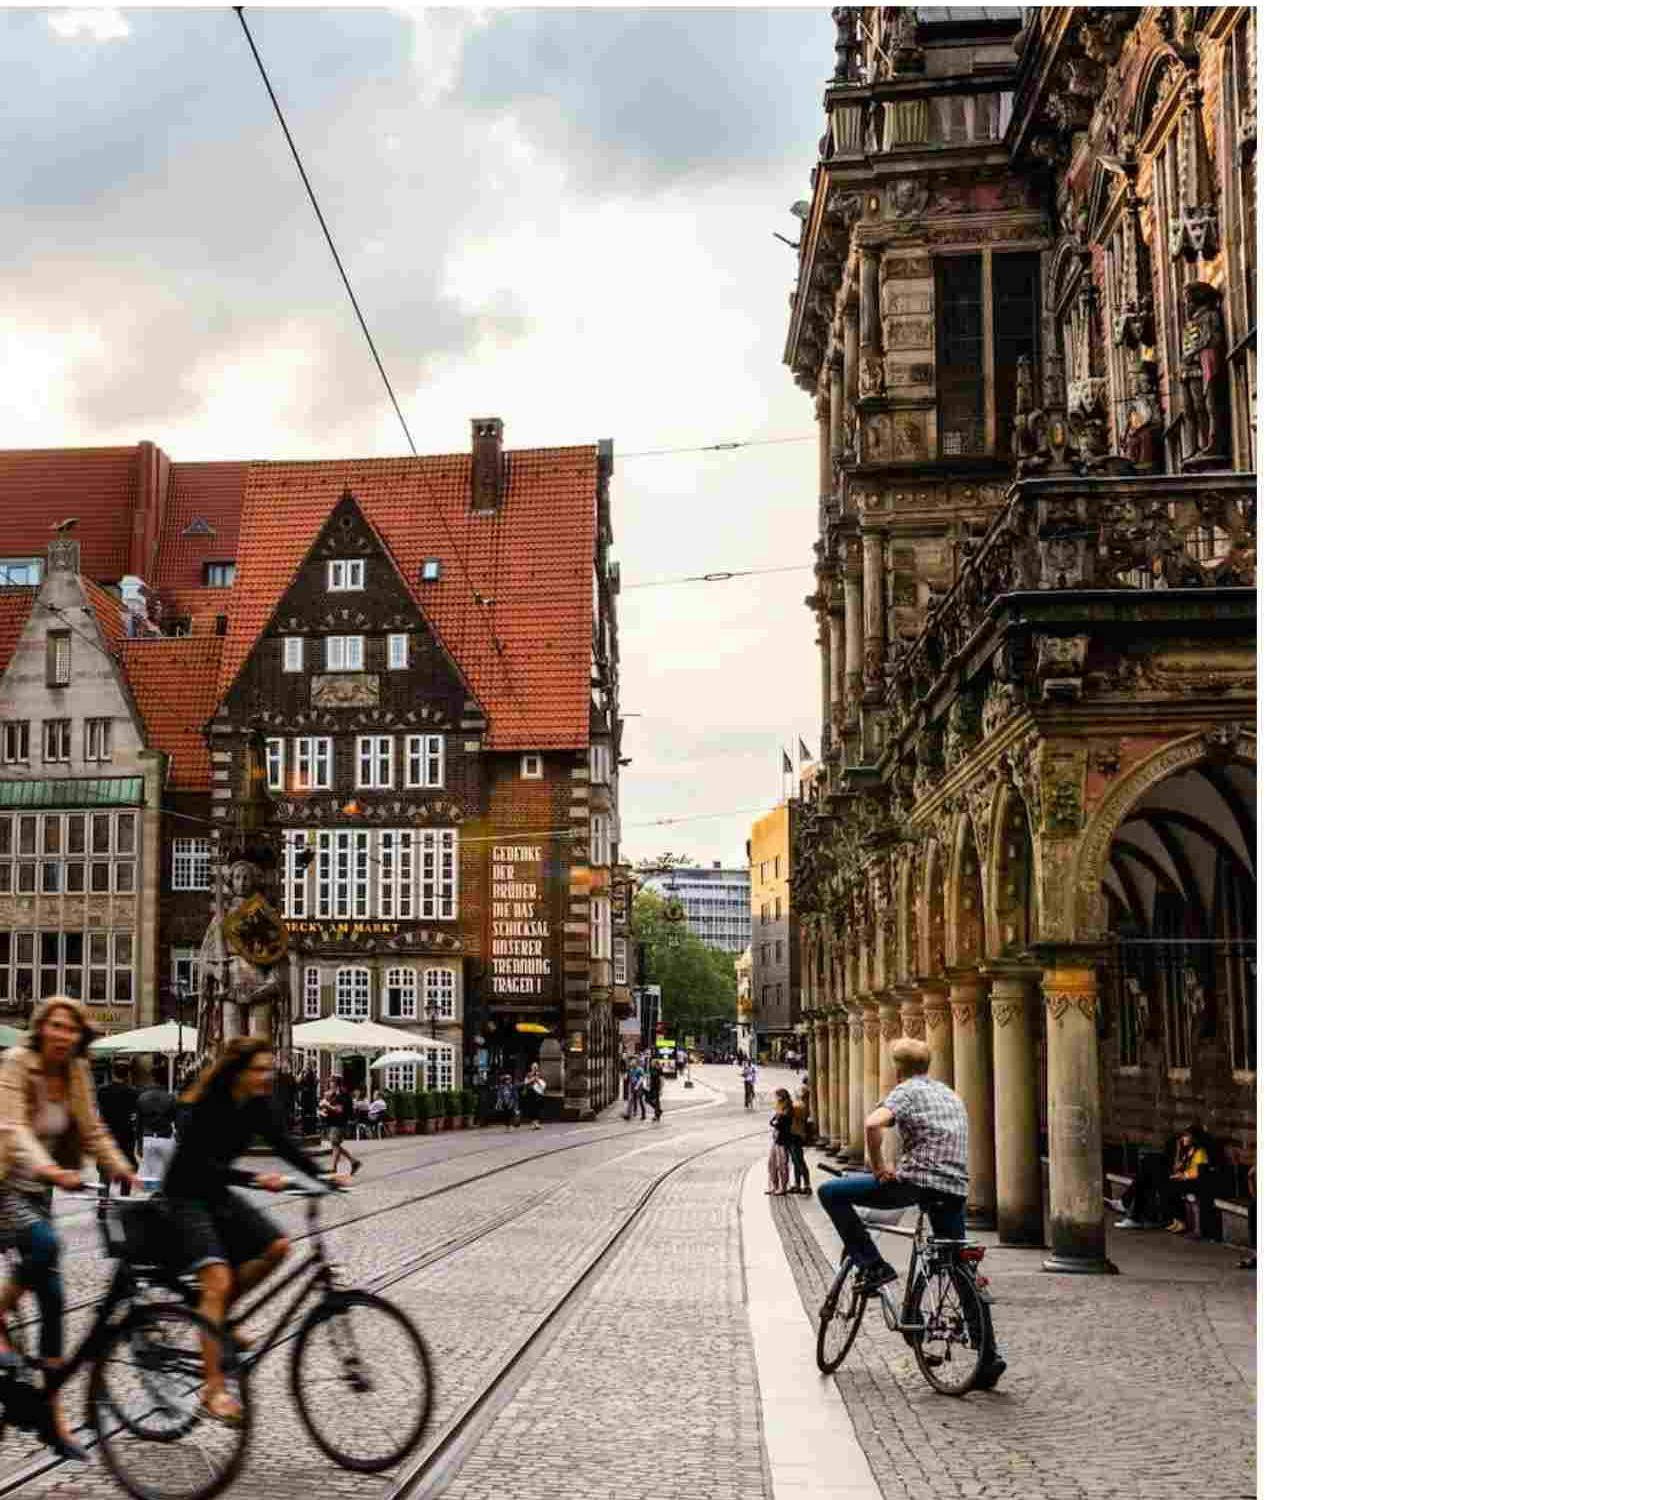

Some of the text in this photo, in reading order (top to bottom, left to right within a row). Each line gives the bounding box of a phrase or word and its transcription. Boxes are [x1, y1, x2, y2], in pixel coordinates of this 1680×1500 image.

[492, 846, 542, 861] GEDENKE
[492, 864, 514, 880] DER
[492, 902, 535, 918] DIE DAS
[328, 923, 349, 933] AM
[353, 923, 400, 934] MARKT
[492, 921, 550, 937] SCHICKSAL
[492, 940, 542, 955] UNSERER
[493, 958, 551, 974] TRENNUNG
